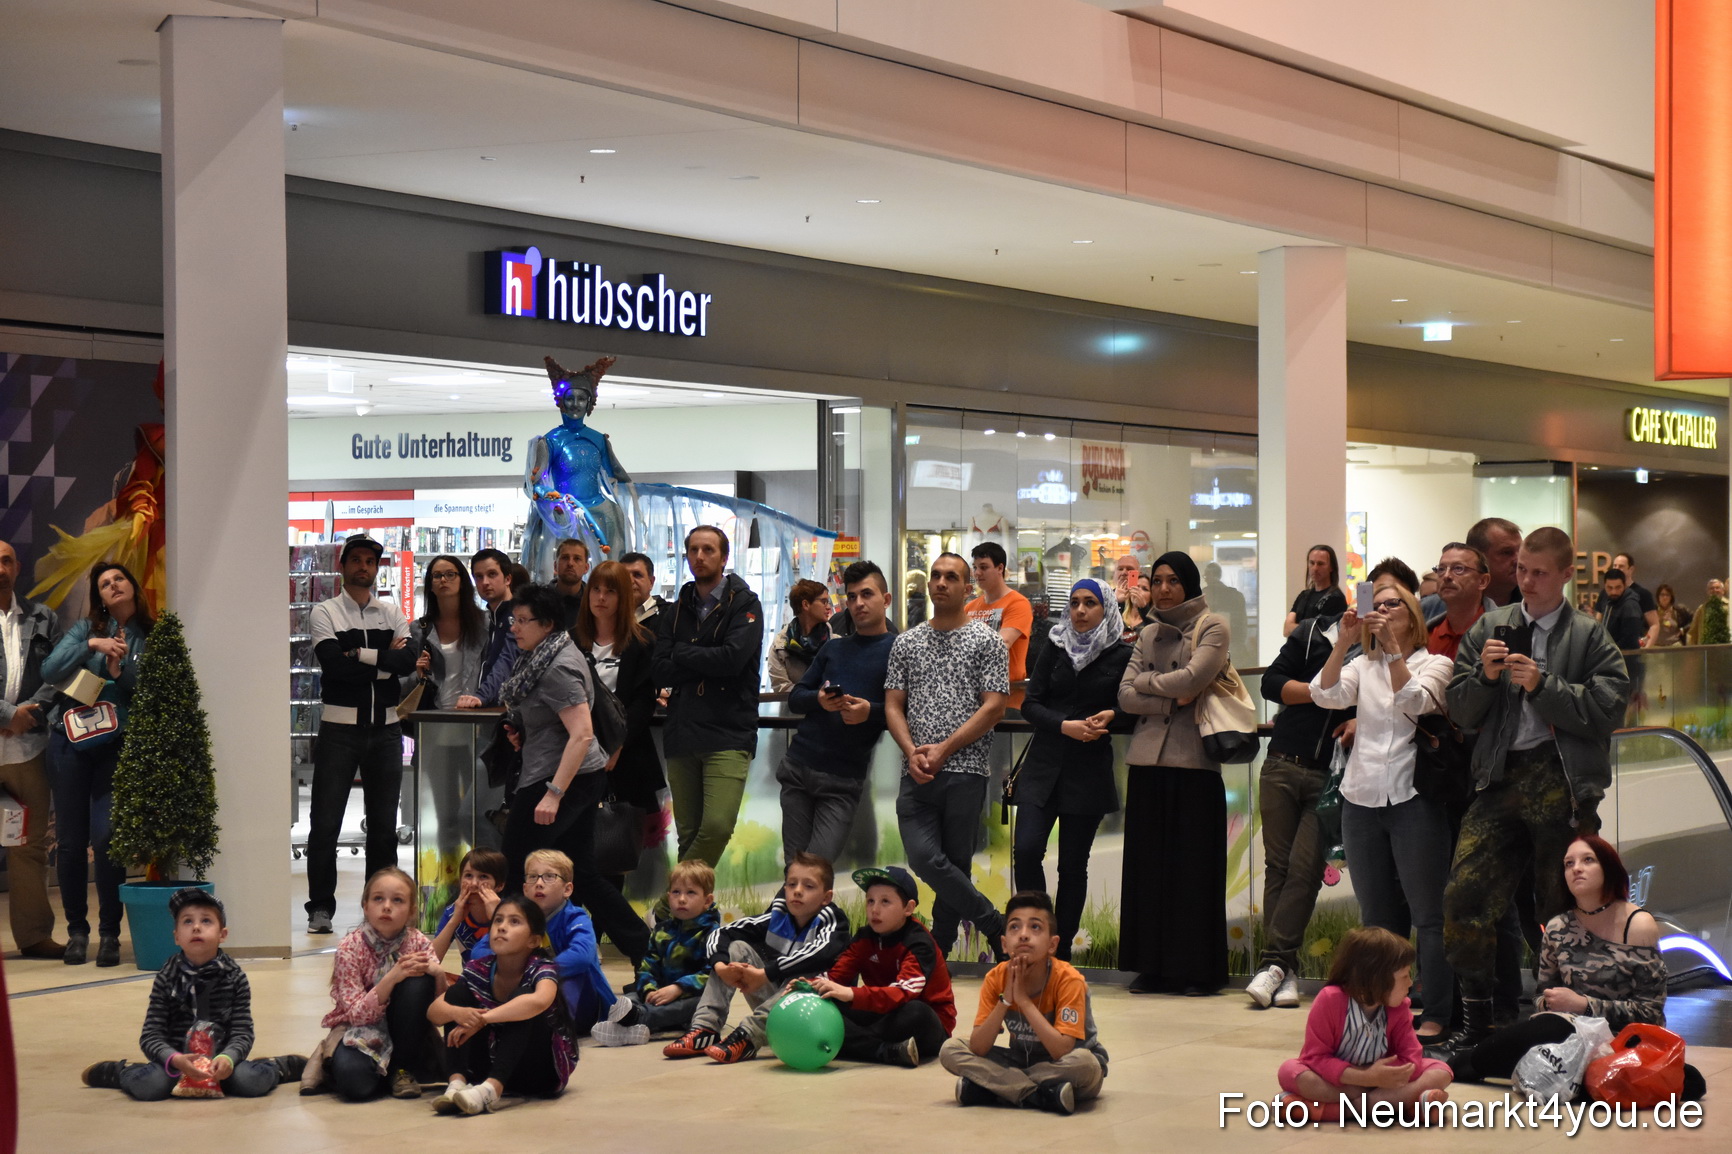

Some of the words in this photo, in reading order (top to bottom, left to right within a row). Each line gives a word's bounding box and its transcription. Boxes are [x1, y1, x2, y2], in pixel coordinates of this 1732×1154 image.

[548, 258, 712, 337] hübscher
[1632, 406, 1662, 444] CAFE
[1663, 410, 1717, 450] SCHALLER
[352, 433, 392, 459] Gute
[398, 431, 513, 463] Unterhaltung
[356, 505, 383, 515] Gespräch
[433, 504, 443, 512] die
[444, 503, 473, 514] Spannung
[1061, 1007, 1079, 1025] 69
